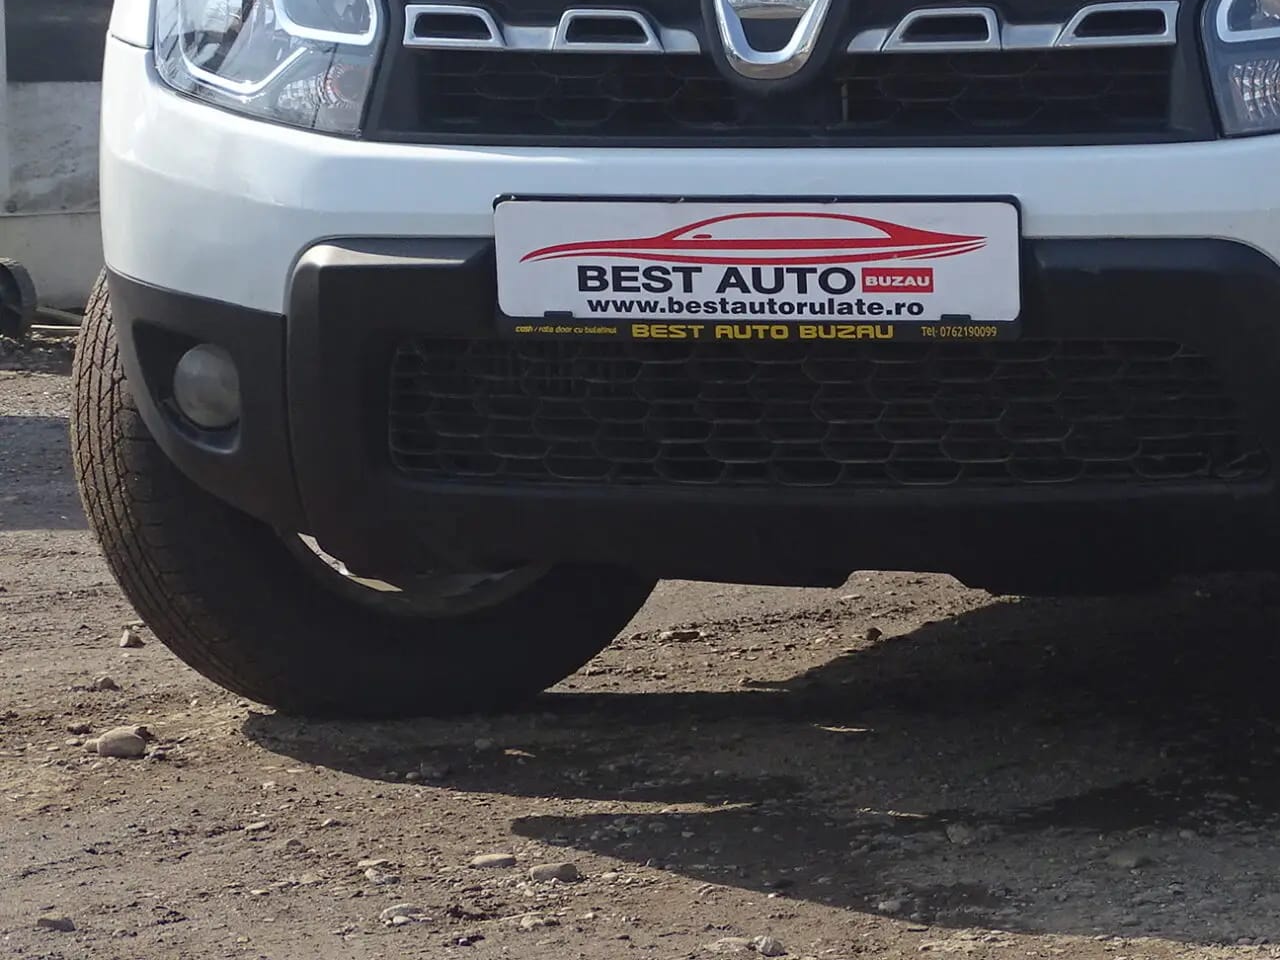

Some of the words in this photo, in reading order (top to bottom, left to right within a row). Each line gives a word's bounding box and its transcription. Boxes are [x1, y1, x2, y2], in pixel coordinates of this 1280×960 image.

[577, 264, 703, 295] BEST
[715, 264, 856, 295] AUTO
[865, 274, 931, 289] BUZAU
[587, 296, 924, 316] www.bestautorulate.ro
[631, 323, 704, 338] BEST
[714, 323, 789, 340] AUTO
[799, 324, 894, 341] BUZAU
[939, 326, 998, 337] 0762190099
